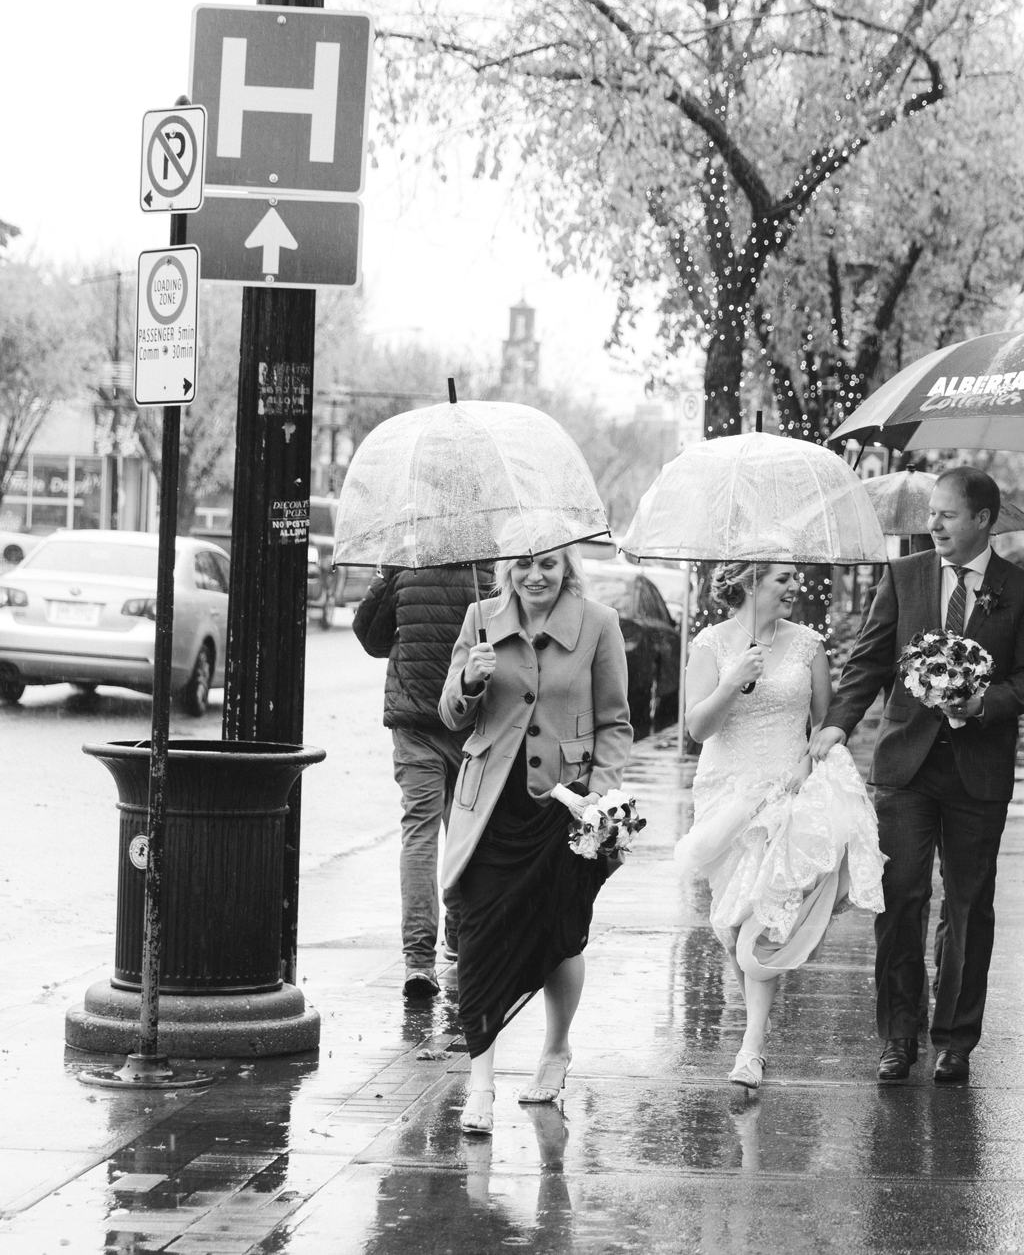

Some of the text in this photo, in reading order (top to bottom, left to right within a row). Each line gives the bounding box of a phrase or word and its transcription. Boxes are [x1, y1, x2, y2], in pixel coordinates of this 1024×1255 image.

[217, 37, 340, 163] H
[154, 279, 182, 292] LOADING
[160, 293, 176, 305] ZONE
[138, 325, 194, 342] PASSENGER 5min
[140, 343, 194, 360] Comm 30min
[272, 520, 284, 528] NO
